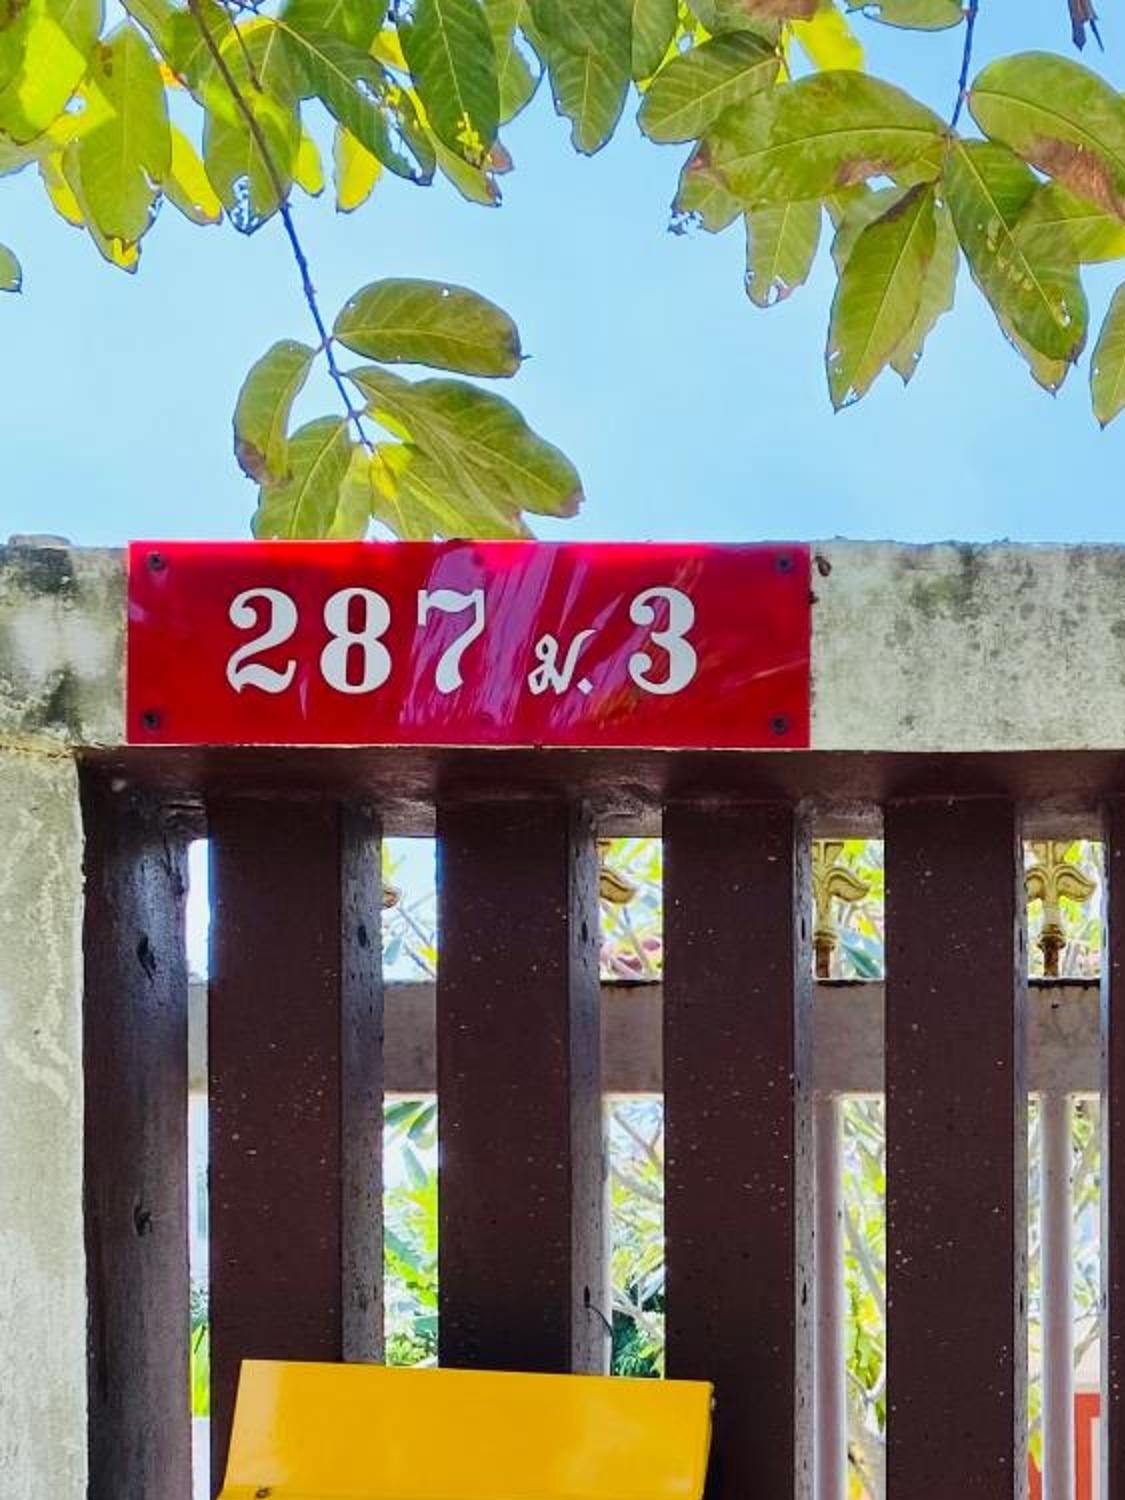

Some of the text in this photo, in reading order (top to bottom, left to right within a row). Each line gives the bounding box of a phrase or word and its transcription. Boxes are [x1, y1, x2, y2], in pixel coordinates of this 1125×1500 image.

[227, 587, 697, 695] 287 ม. 3
